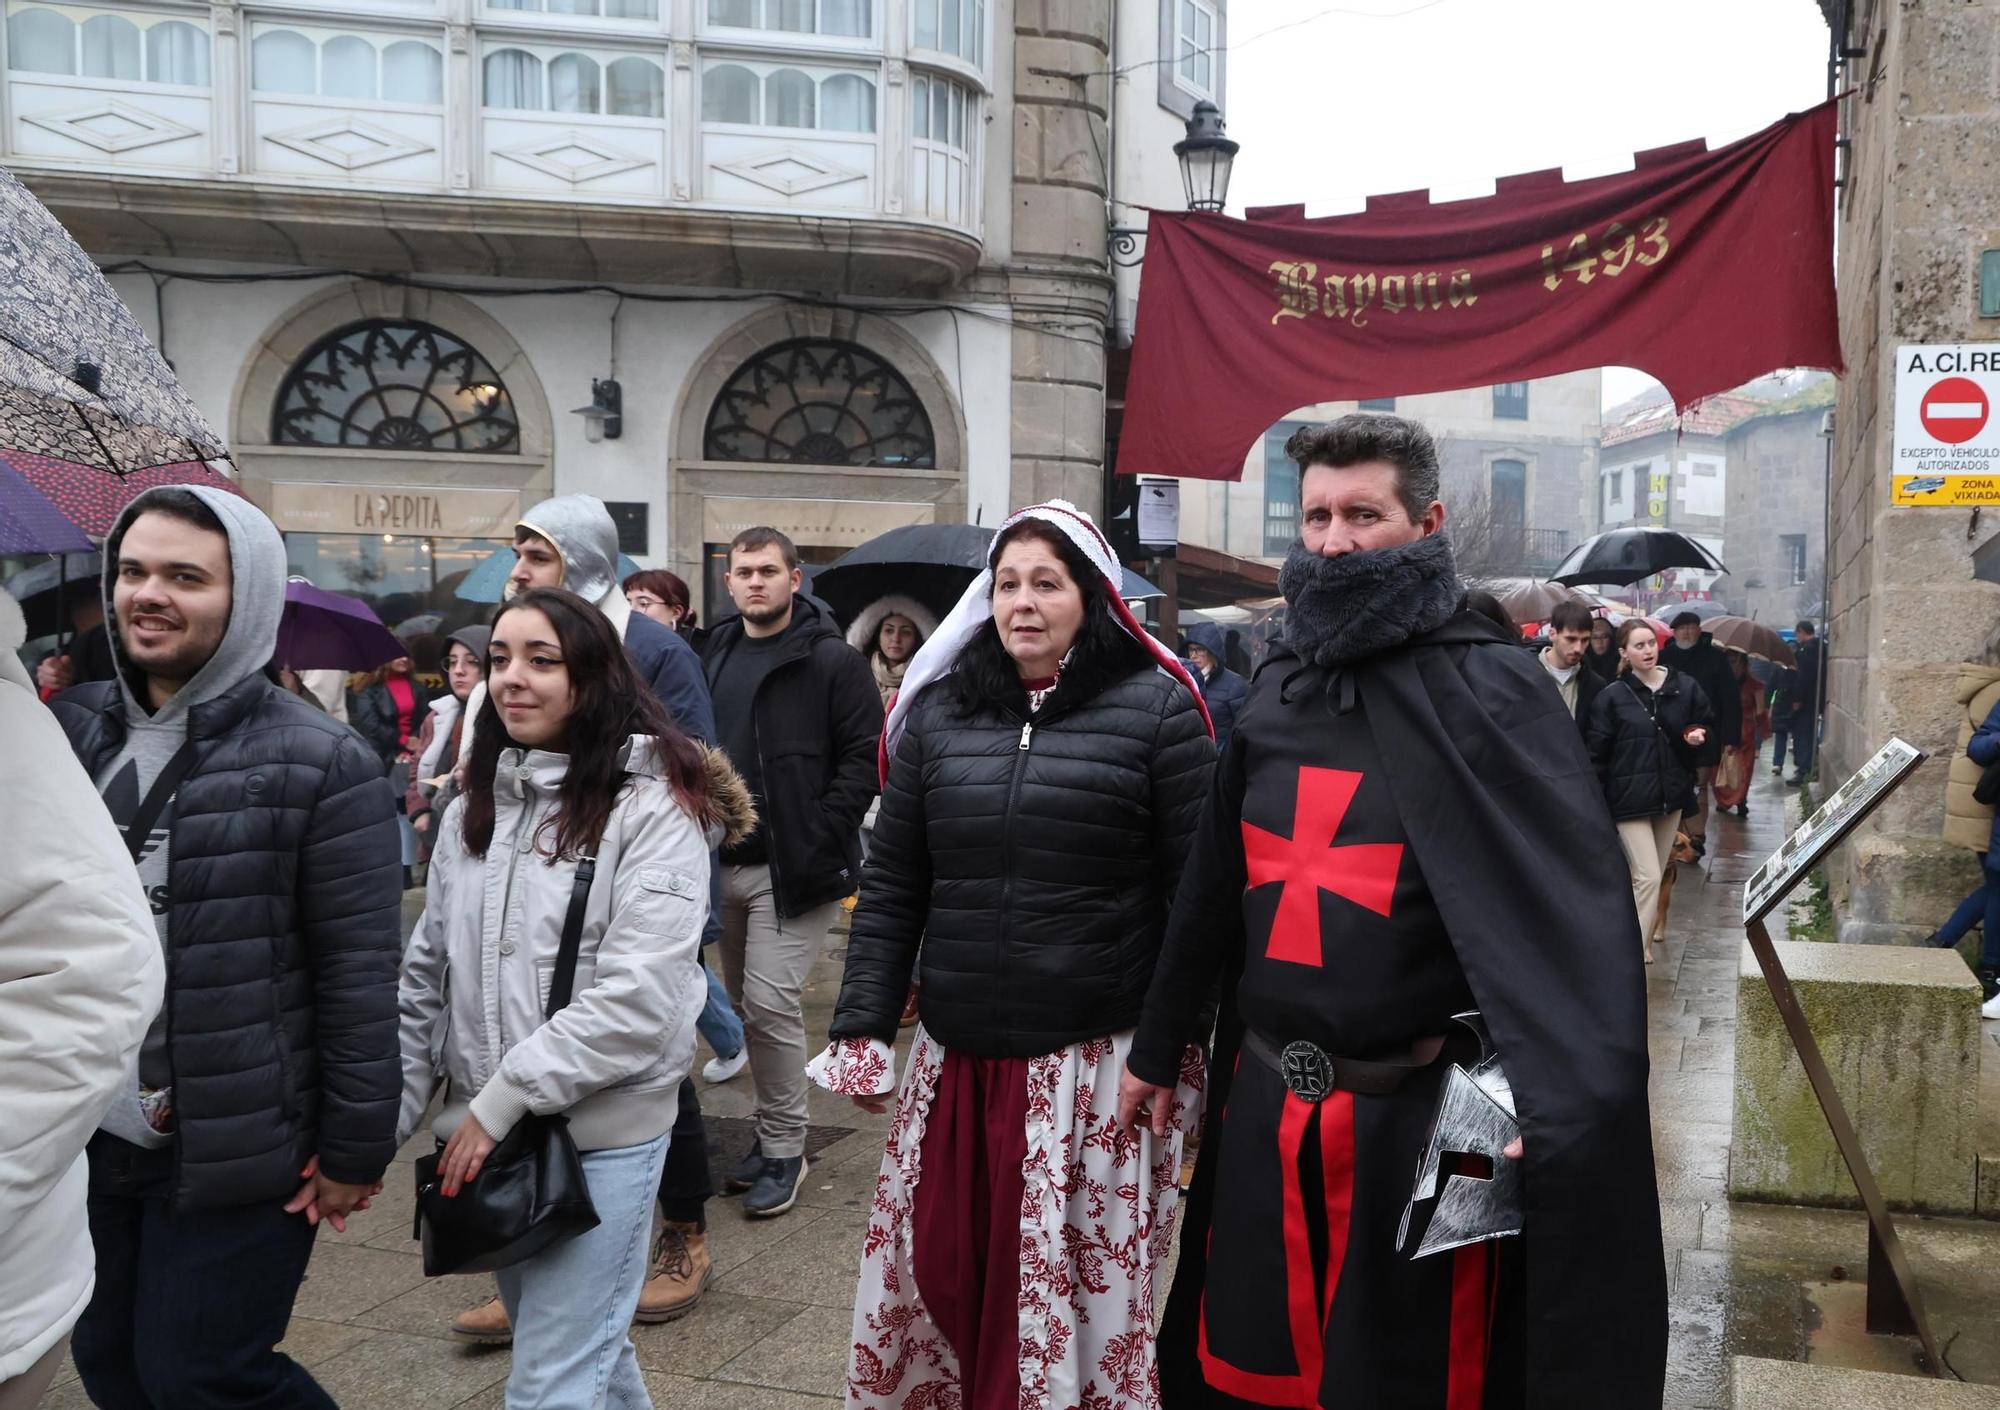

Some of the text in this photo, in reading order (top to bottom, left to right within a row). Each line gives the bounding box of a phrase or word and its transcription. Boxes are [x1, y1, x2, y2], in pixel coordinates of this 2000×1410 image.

[1268, 217, 1670, 327] Bayona 1493
[1901, 448, 2000, 458] EXCEPTO VEHICULO
[1917, 460, 1990, 470] AUTORIZADOS
[1961, 480, 1994, 489] ZONA
[1954, 491, 2000, 500] VIXIADA
[354, 494, 442, 529] LA PEPITA
